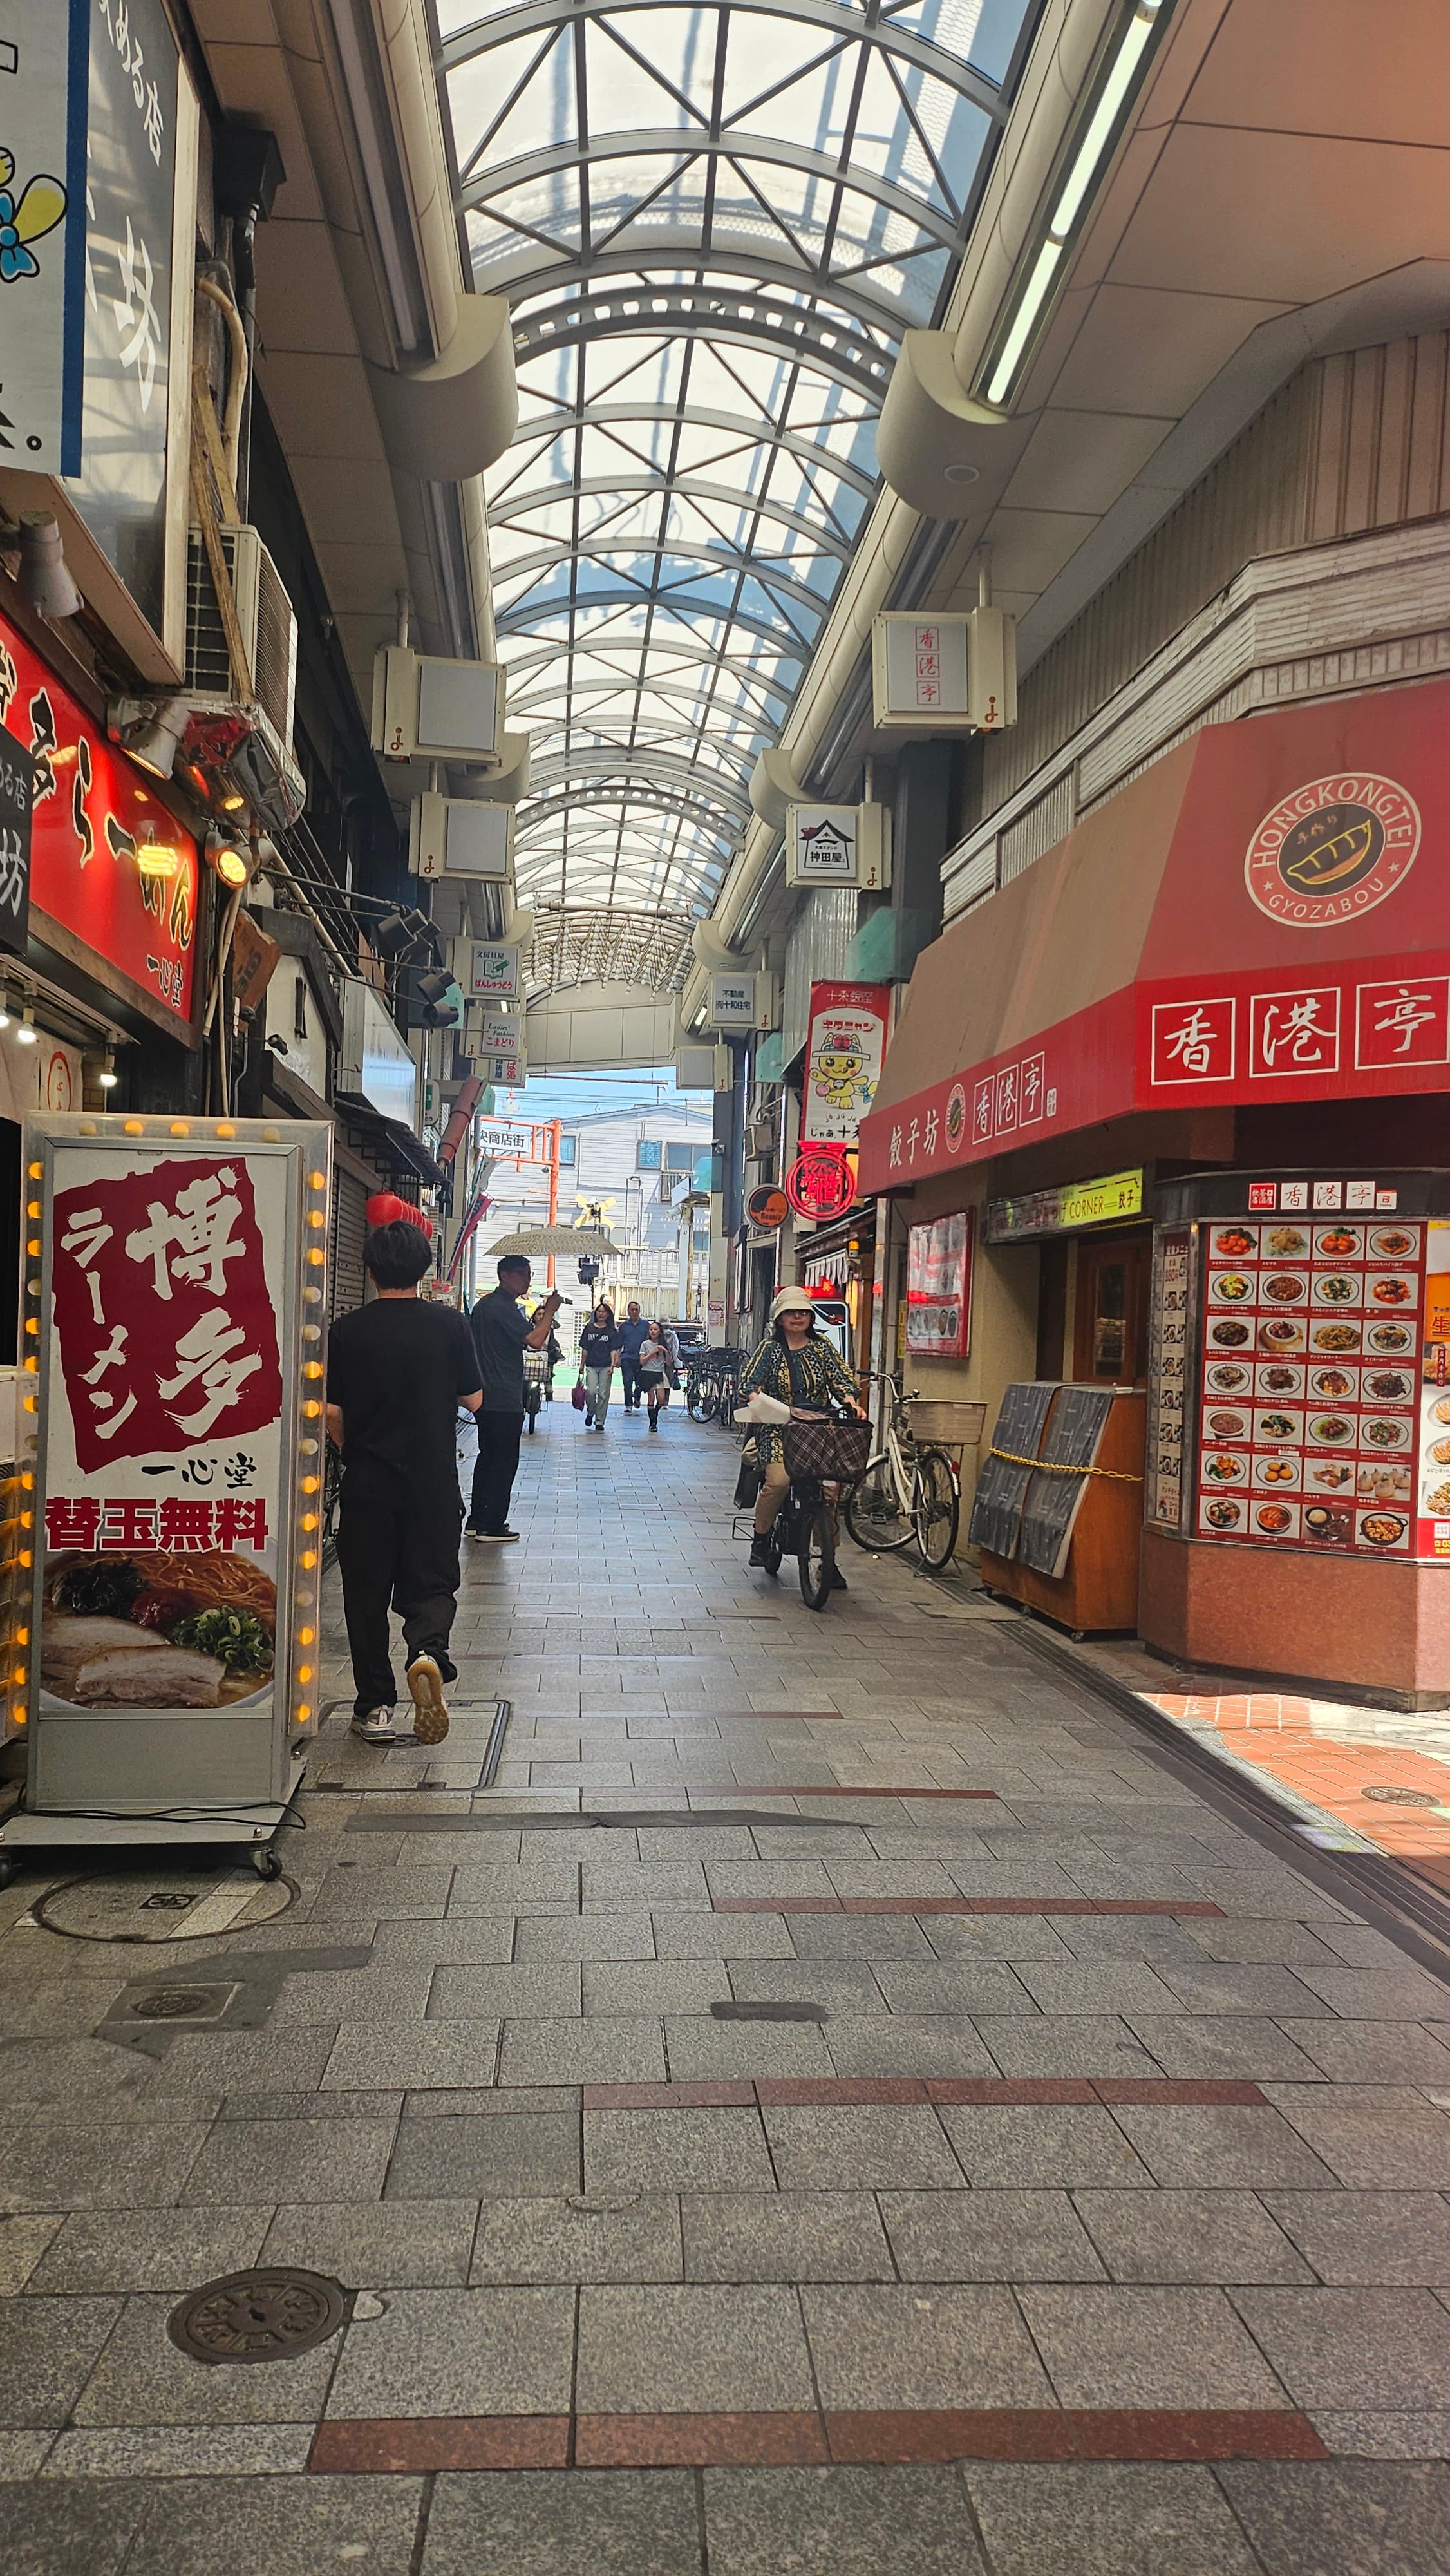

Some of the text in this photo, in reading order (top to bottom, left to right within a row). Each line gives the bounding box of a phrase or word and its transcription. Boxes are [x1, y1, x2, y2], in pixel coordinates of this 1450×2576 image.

[919, 628, 939, 701] 香港亭
[1252, 779, 1413, 869] HONGKONGTEI
[811, 851, 842, 862] 神田屋
[1269, 877, 1384, 918] GYOZABOU
[827, 990, 873, 1003] 十条銀座
[487, 1037, 515, 1048] こまどり
[823, 1020, 874, 1032] キタニャン
[1164, 989, 1436, 1073] 香港亭
[976, 1063, 1040, 1133] 香港亭
[889, 1109, 939, 1170] 餃子坊
[1069, 1196, 1103, 1218] CORNER
[1285, 1185, 1371, 1206] 香港亭
[60, 1206, 138, 1440] ラーメン
[126, 1164, 263, 1439] 博多
[141, 1452, 257, 1489] 一心堂
[44, 1497, 269, 1553] 替玉無料
